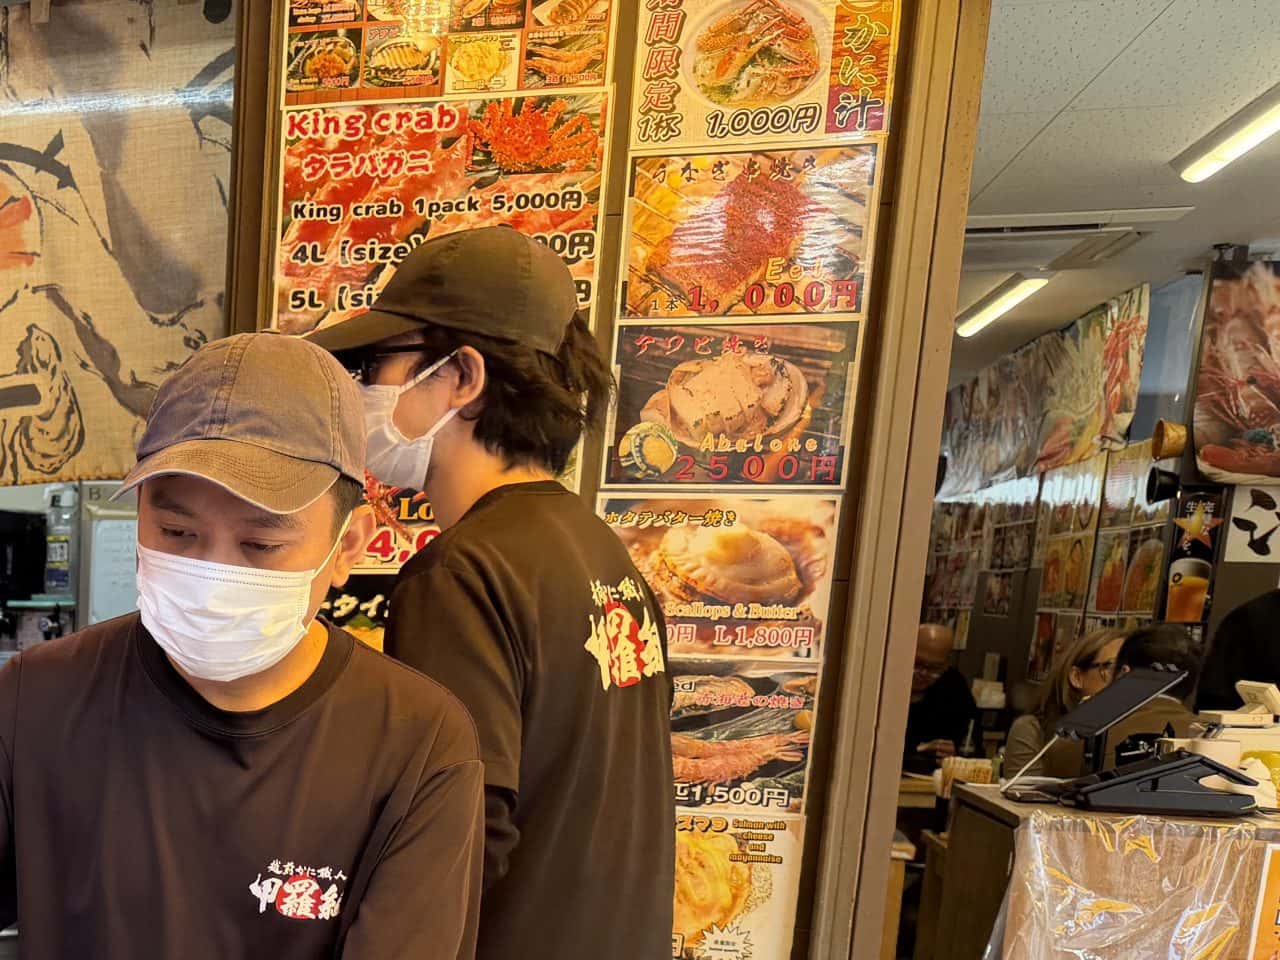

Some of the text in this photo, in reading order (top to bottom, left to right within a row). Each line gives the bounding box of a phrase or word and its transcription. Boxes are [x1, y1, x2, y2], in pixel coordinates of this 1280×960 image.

[834, 14, 889, 131] かに汁
[287, 103, 460, 141] King crab
[638, 103, 822, 141] 1杯 1,000円
[302, 151, 433, 180] タラバガニ
[293, 190, 583, 221] King crab 1pack 5,000円
[291, 243, 325, 264] 4L
[766, 257, 827, 282] Eel
[290, 289, 322, 311] 5L
[651, 280, 859, 314] 1本 1,000円
[700, 432, 818, 452] Abalone
[675, 455, 837, 481] 2500円
[605, 510, 737, 528] ホタテバター焼き
[665, 603, 800, 620] Scallops & Butter
[713, 625, 731, 646] L
[734, 626, 815, 648] 1,800円
[249, 873, 344, 920] 甲羅組
